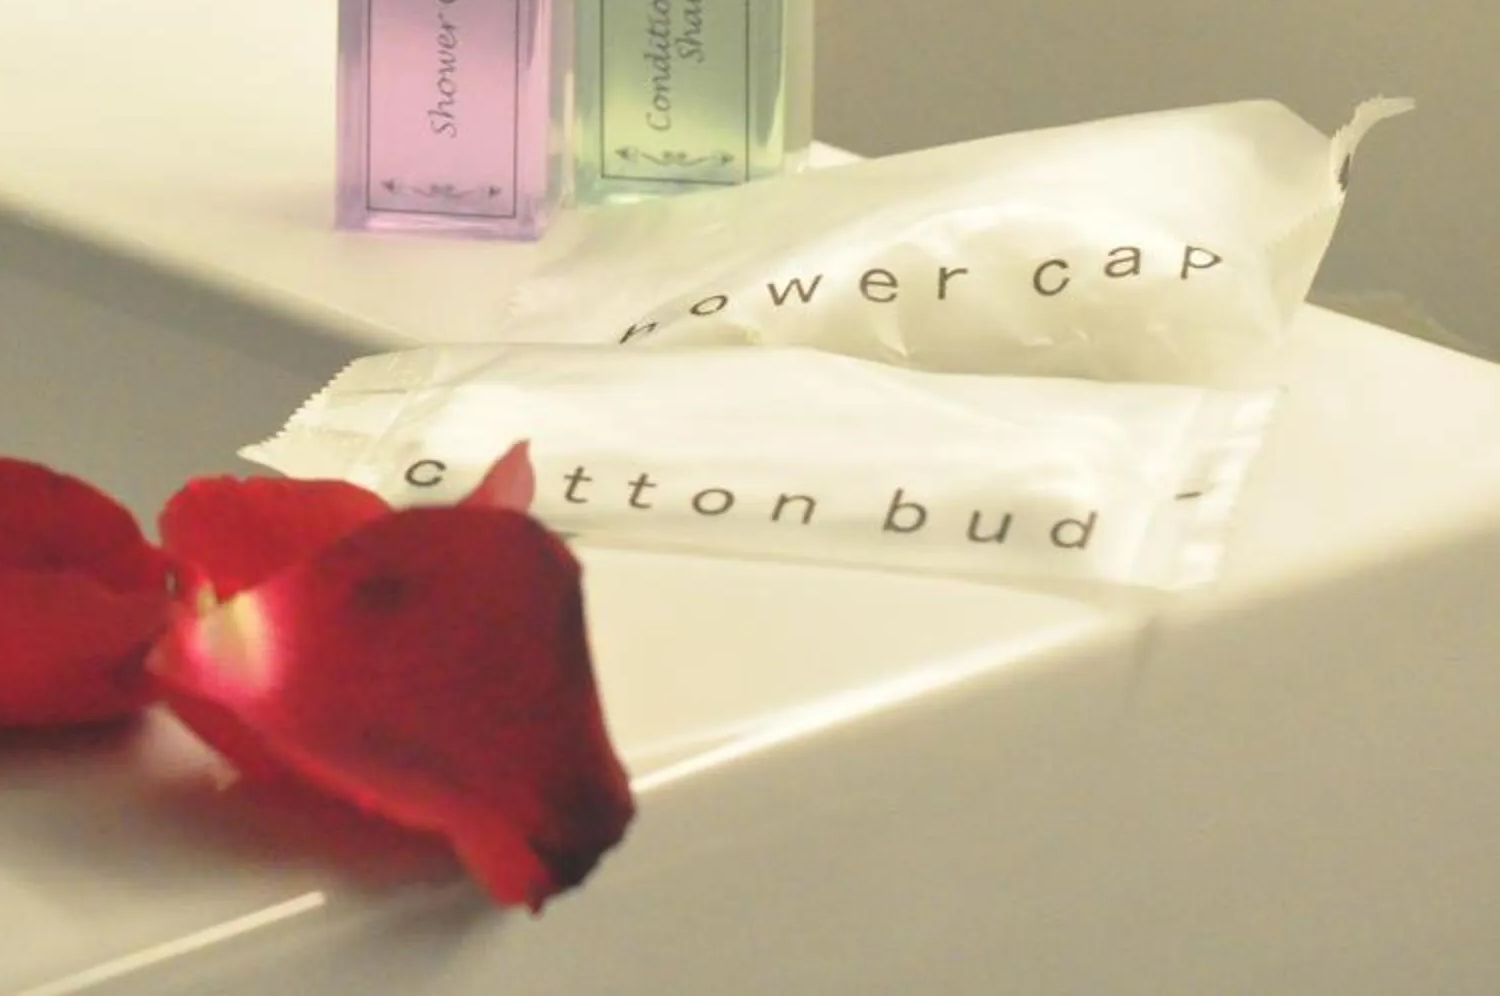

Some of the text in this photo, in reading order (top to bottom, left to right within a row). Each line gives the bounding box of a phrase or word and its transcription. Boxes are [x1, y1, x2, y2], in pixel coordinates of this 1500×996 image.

[427, 10, 458, 138] Shower
[1032, 243, 1222, 298] cap
[403, 458, 1208, 550] ctton bud
